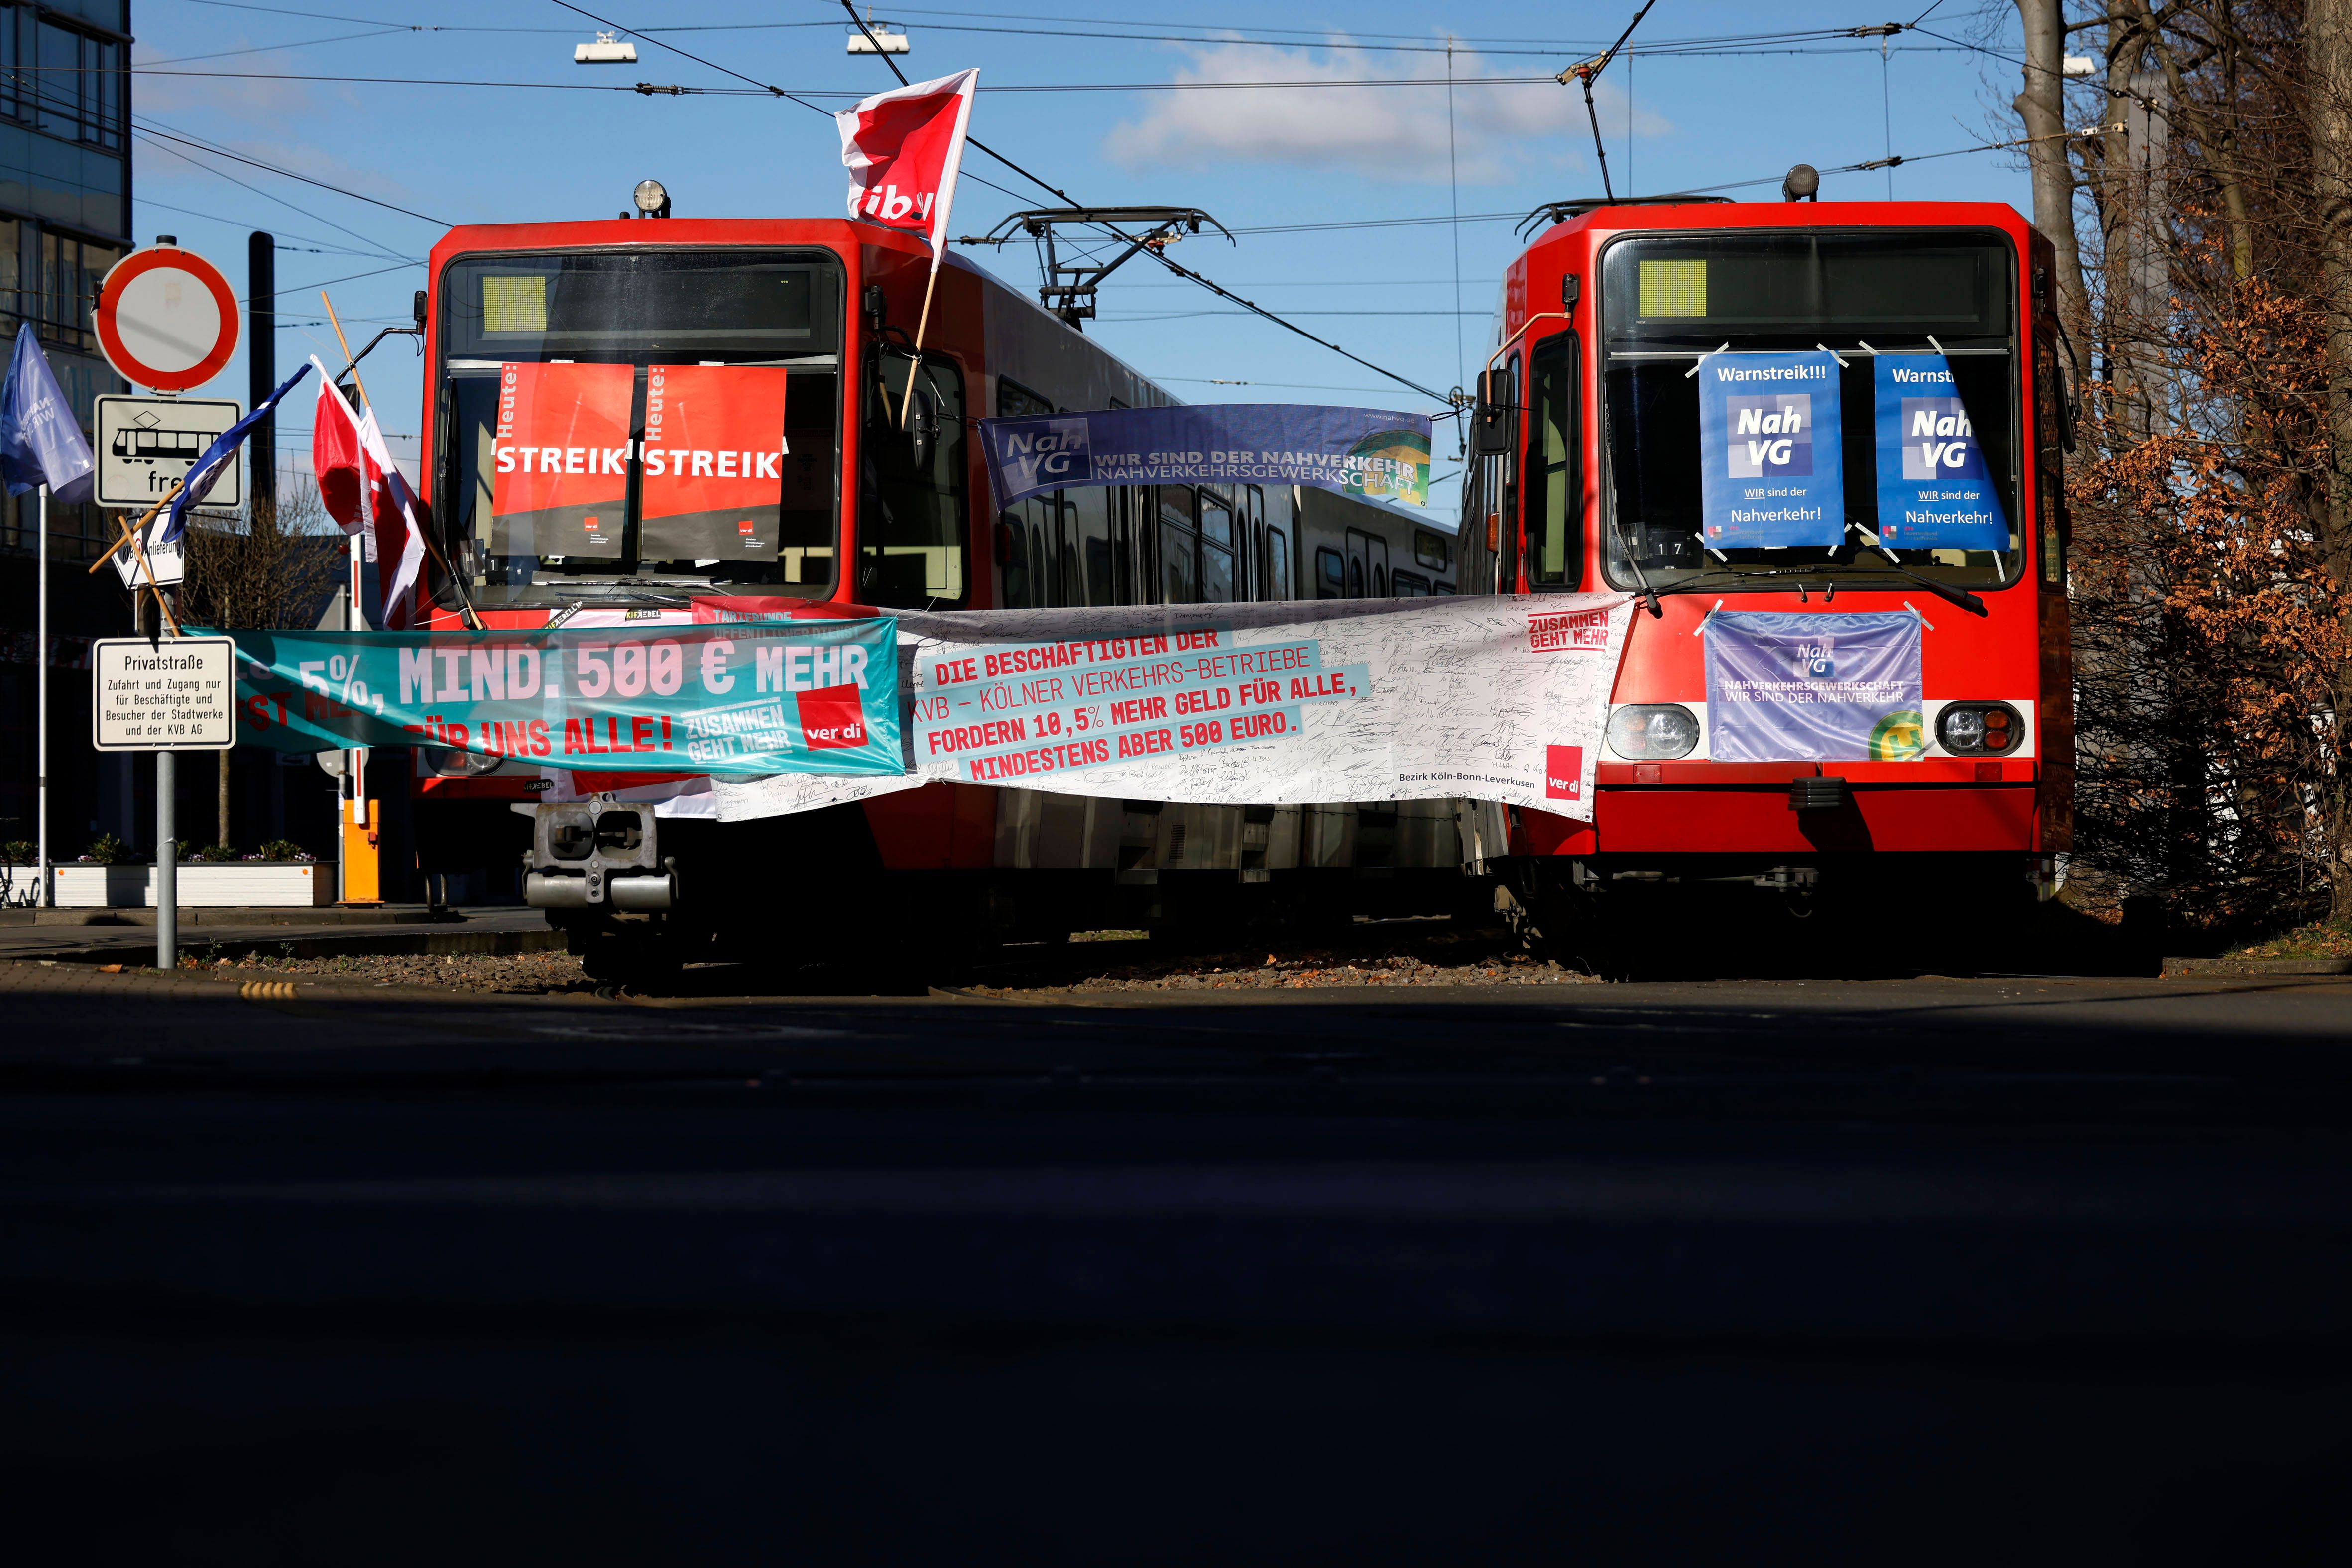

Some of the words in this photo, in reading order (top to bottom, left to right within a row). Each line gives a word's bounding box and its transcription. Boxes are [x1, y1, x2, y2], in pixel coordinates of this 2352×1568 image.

[1717, 365, 1825, 381] Warnstreik!!!
[498, 365, 517, 439] Heute:
[645, 368, 665, 441] Heute:
[1364, 412, 1415, 424] www.nahvg.de
[1737, 406, 1802, 435] Nah
[1912, 410, 1971, 437] Nah
[1006, 429, 1082, 457] Nah
[1748, 439, 1793, 466] VG
[497, 446, 625, 475] STREIK
[645, 449, 781, 479] STREIK
[1019, 452, 1070, 480] VG
[1095, 453, 1140, 467] WIR
[1149, 450, 1203, 465] SIND
[1211, 450, 1254, 464] DER
[1263, 450, 1414, 479] NAHVERKEHR
[1922, 442, 1966, 468] VG
[149, 471, 184, 492] fre
[1097, 463, 1415, 497] NAHVERKEHRSGEWERKSCHAFT
[1744, 487, 1765, 499] WIR
[1767, 486, 1788, 497] sind
[1790, 486, 1807, 497] der
[1918, 490, 1939, 501] WIR
[1941, 489, 1960, 500] sind
[1964, 489, 1980, 500] der
[1732, 507, 1820, 522] Nahverkehr!
[1906, 511, 1992, 524] Nahverkehr!
[713, 609, 791, 622] TARIFRUNDE
[1528, 611, 1609, 634] ZUSAMMEN
[1530, 630, 1568, 648] GEHT
[1574, 628, 1609, 646] MEHR
[936, 658, 977, 685] DIE
[984, 632, 1169, 678] BESCHÄFTIGTEN
[1176, 628, 1219, 651] DER
[1797, 642, 1833, 658] Nah
[125, 655, 202, 670] Privatstraße
[399, 644, 559, 705] MIND.
[577, 638, 682, 698] 500
[701, 638, 735, 694] €
[756, 645, 869, 692] MEHR
[1802, 659, 1826, 673] VG
[109, 680, 139, 690] Zufahrt
[146, 679, 160, 689] und
[167, 679, 199, 691] Zugang
[1725, 681, 1904, 692] NAHVERKEHRSGEWERKSCHAFT
[117, 695, 128, 705] für
[134, 694, 190, 707] Beschäftigte
[197, 694, 211, 703] und
[907, 697, 949, 725] KVB
[979, 676, 1064, 713] KÖLNER
[1725, 691, 1751, 702] WIR
[1754, 691, 1784, 702] SIND
[1788, 693, 1814, 704] DER
[1817, 691, 1905, 703] NAHVERKEHR
[107, 710, 145, 720] Besucher
[152, 710, 165, 719] der
[172, 709, 222, 719] Stadtwerke
[682, 704, 785, 740] ZUSAMMEN
[928, 717, 1026, 756] FORDERN
[1033, 705, 1105, 740] 10,5%
[1110, 697, 1167, 726] MEHR
[1175, 687, 1231, 716] GELD
[1239, 678, 1281, 707] FÜR
[1290, 672, 1357, 701] ALLE,
[126, 725, 141, 735] und
[148, 725, 161, 735] der
[168, 725, 184, 734] KVB
[191, 724, 202, 734] AG
[481, 719, 551, 758] UNS
[564, 715, 672, 755] ALLE!
[807, 722, 861, 740] ver.di
[687, 735, 735, 763] GEHT
[741, 729, 792, 756] MEHR
[969, 738, 1110, 782] MINDESTENS
[1118, 728, 1173, 760] ABER
[1180, 720, 1223, 747] 500
[1231, 711, 1297, 741] EURO.
[1400, 773, 1427, 781] Bezirk
[1431, 772, 1535, 789] Köln-Bonn-Leverkusen
[1548, 776, 1579, 794] ver.di
